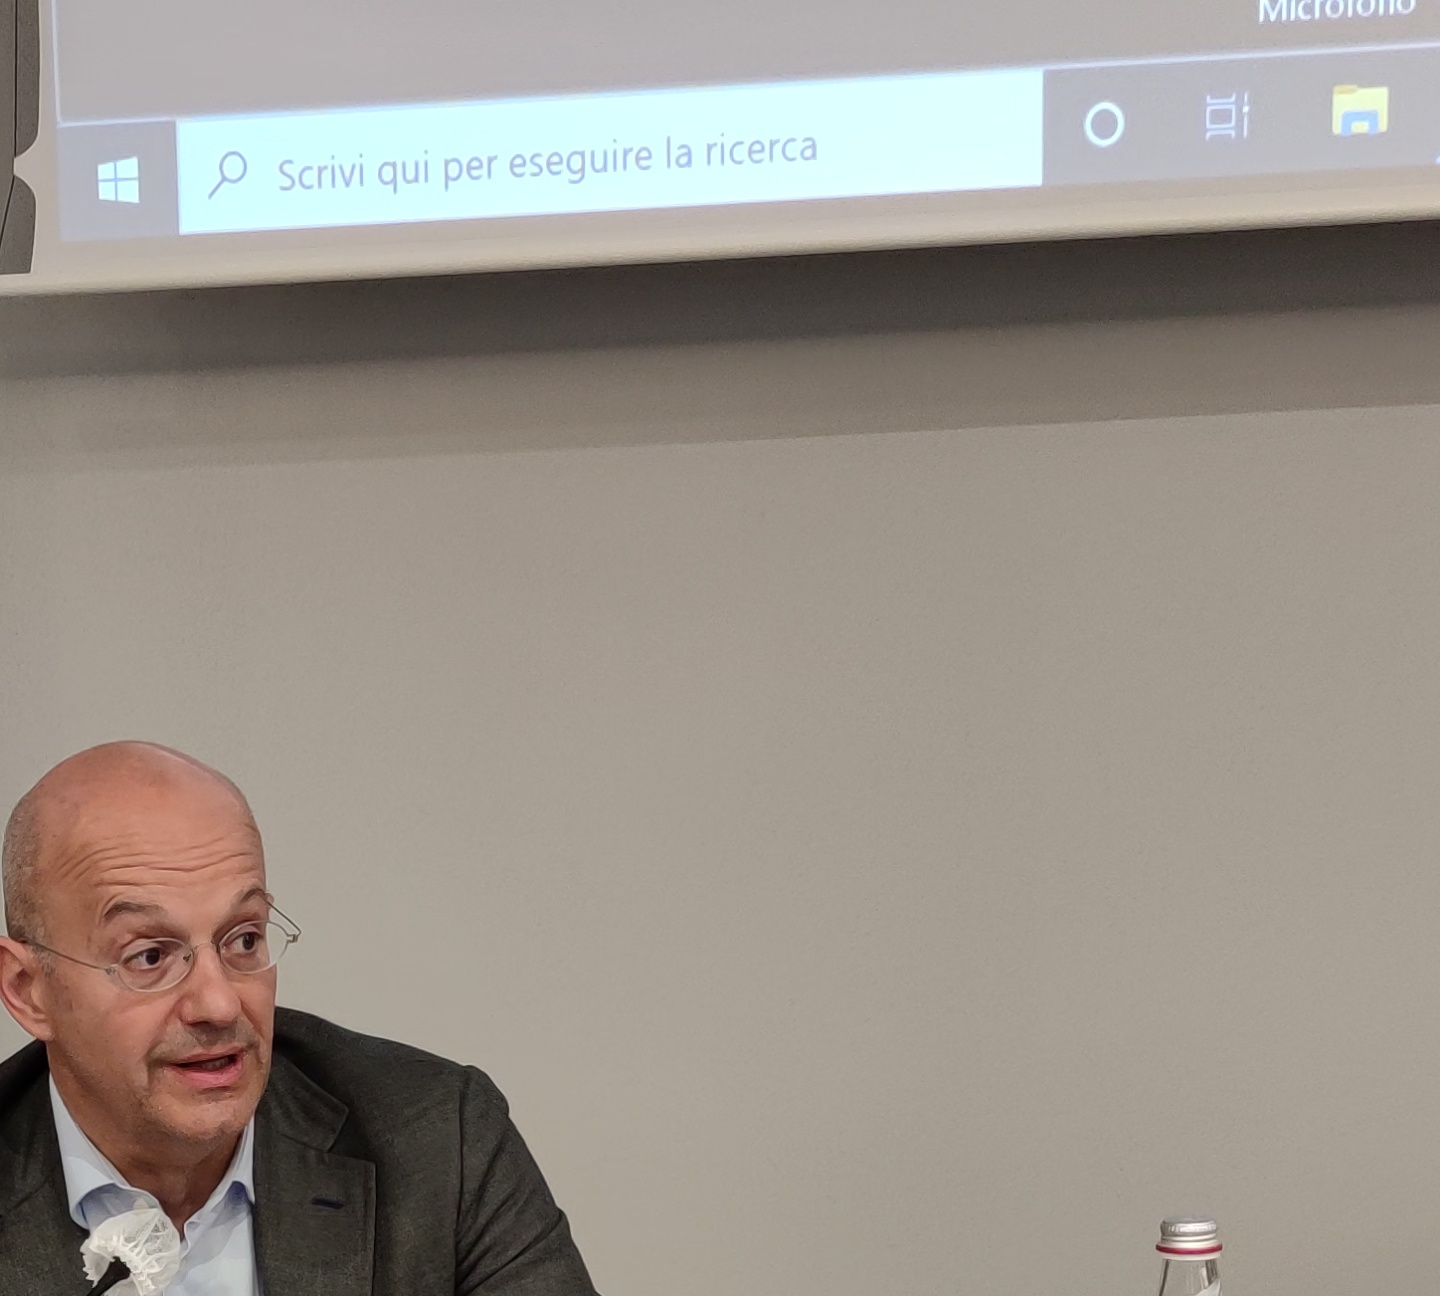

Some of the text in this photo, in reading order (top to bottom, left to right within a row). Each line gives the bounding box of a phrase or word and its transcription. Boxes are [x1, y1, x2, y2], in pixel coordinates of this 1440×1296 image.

[278, 132, 818, 195] Scrivi qui per eseguire la ricerca
